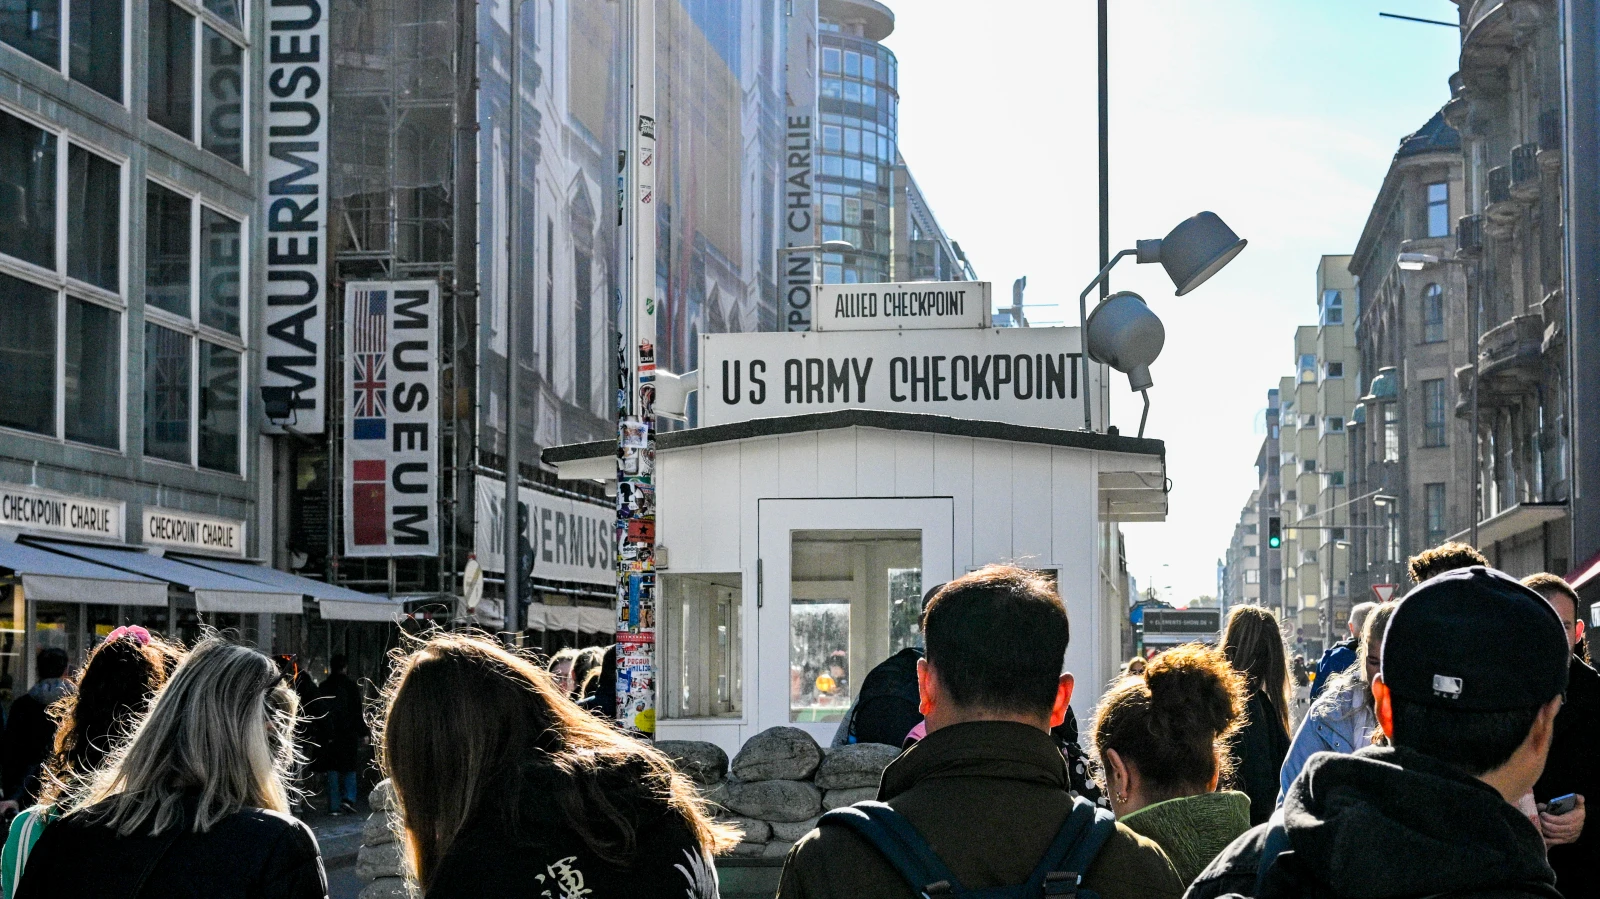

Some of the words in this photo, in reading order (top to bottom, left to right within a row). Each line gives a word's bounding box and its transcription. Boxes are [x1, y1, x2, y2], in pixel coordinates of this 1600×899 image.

[787, 115, 811, 233] CHARLIE
[834, 293, 878, 319] ALLIED
[883, 290, 966, 317] CHECKPOINT
[722, 358, 767, 405] US
[783, 356, 874, 404] ARMY
[889, 352, 1083, 402] CHECKPOINT
[392, 289, 430, 546] MUSEUM
[2, 494, 67, 527] CHECKPOINT
[70, 503, 111, 533] CHARLIE
[149, 515, 200, 545] CHECKPOINT
[202, 523, 234, 548] CHARLIE
